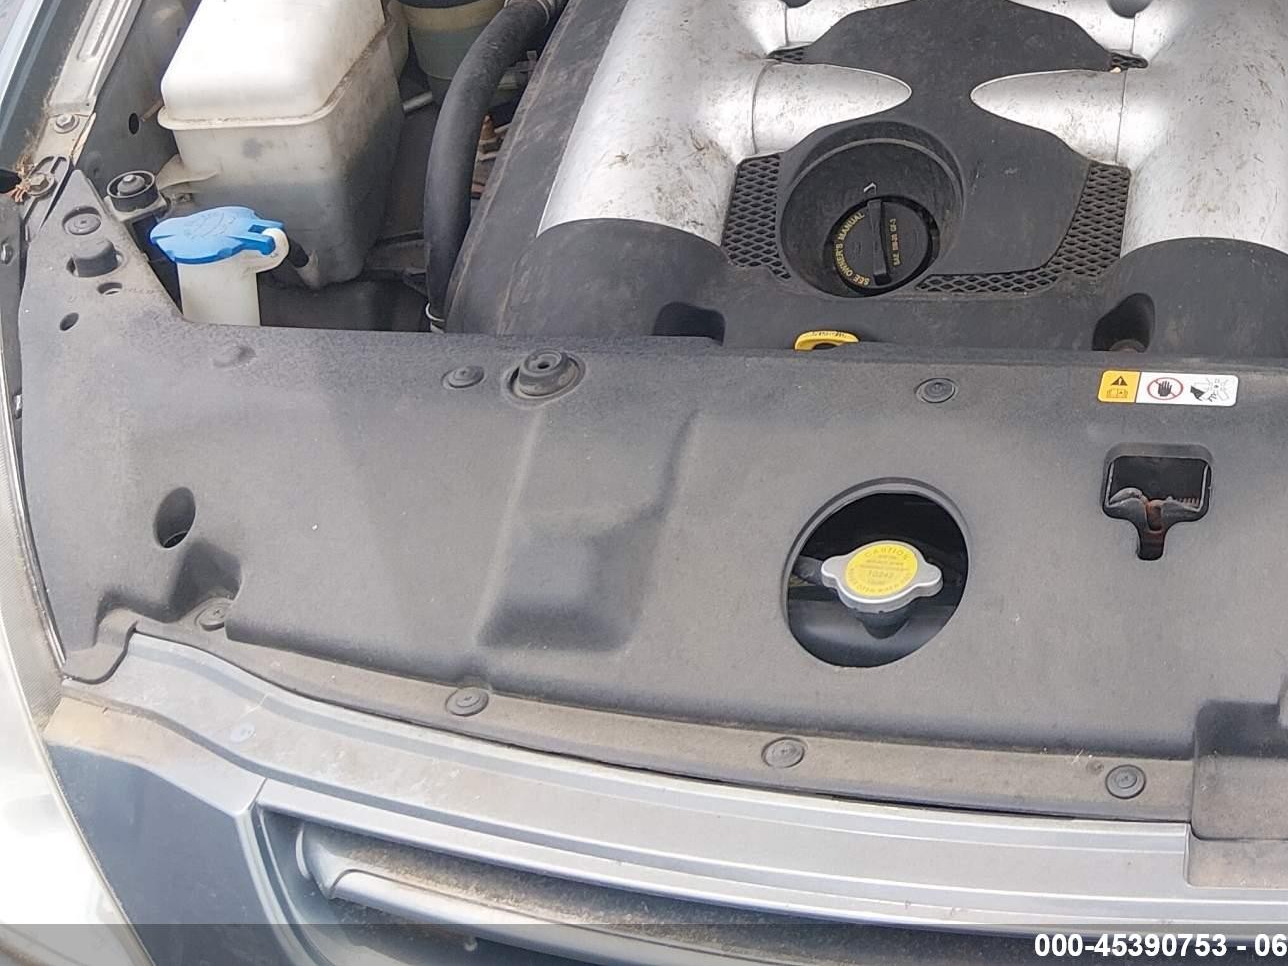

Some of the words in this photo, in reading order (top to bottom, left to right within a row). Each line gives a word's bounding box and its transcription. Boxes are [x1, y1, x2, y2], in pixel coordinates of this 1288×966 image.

[837, 211, 865, 241] MANUAL
[835, 243, 854, 277] OWNER'S
[853, 274, 870, 286] SEE
